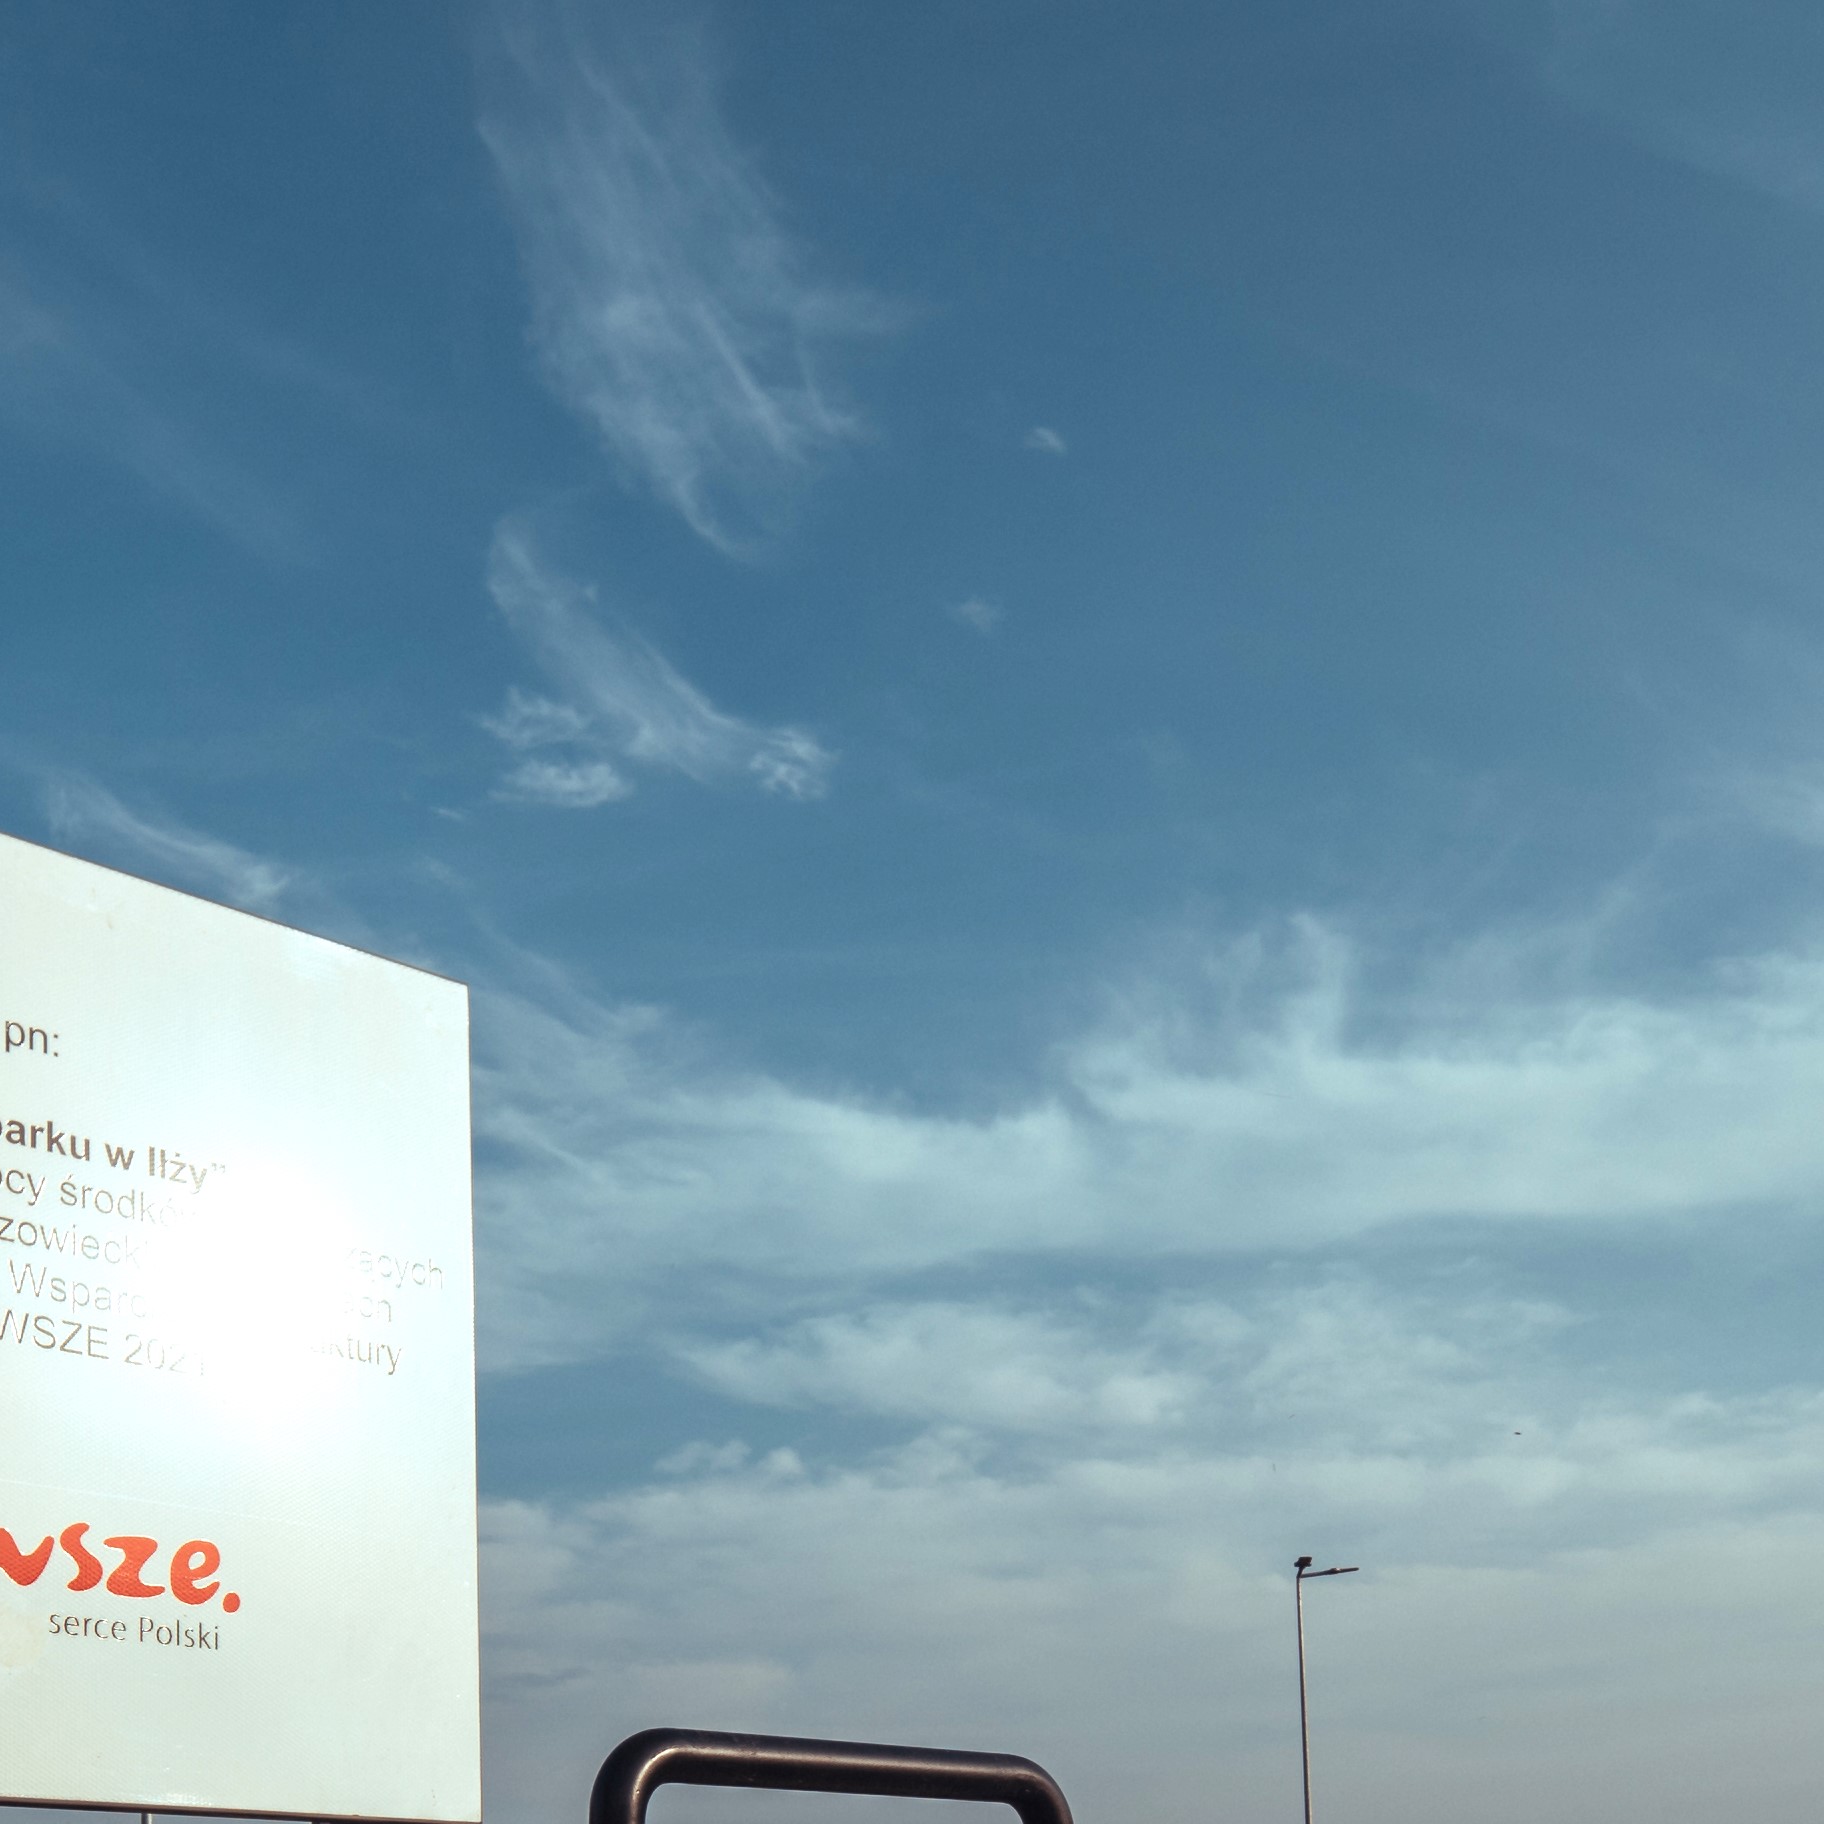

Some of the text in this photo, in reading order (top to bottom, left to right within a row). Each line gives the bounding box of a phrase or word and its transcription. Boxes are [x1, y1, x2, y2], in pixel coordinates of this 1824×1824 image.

[5, 1018, 60, 1057] pn:
[105, 1142, 135, 1171] w
[59, 1176, 200, 1229] środkó
[48, 1612, 221, 1651] serce Polski
